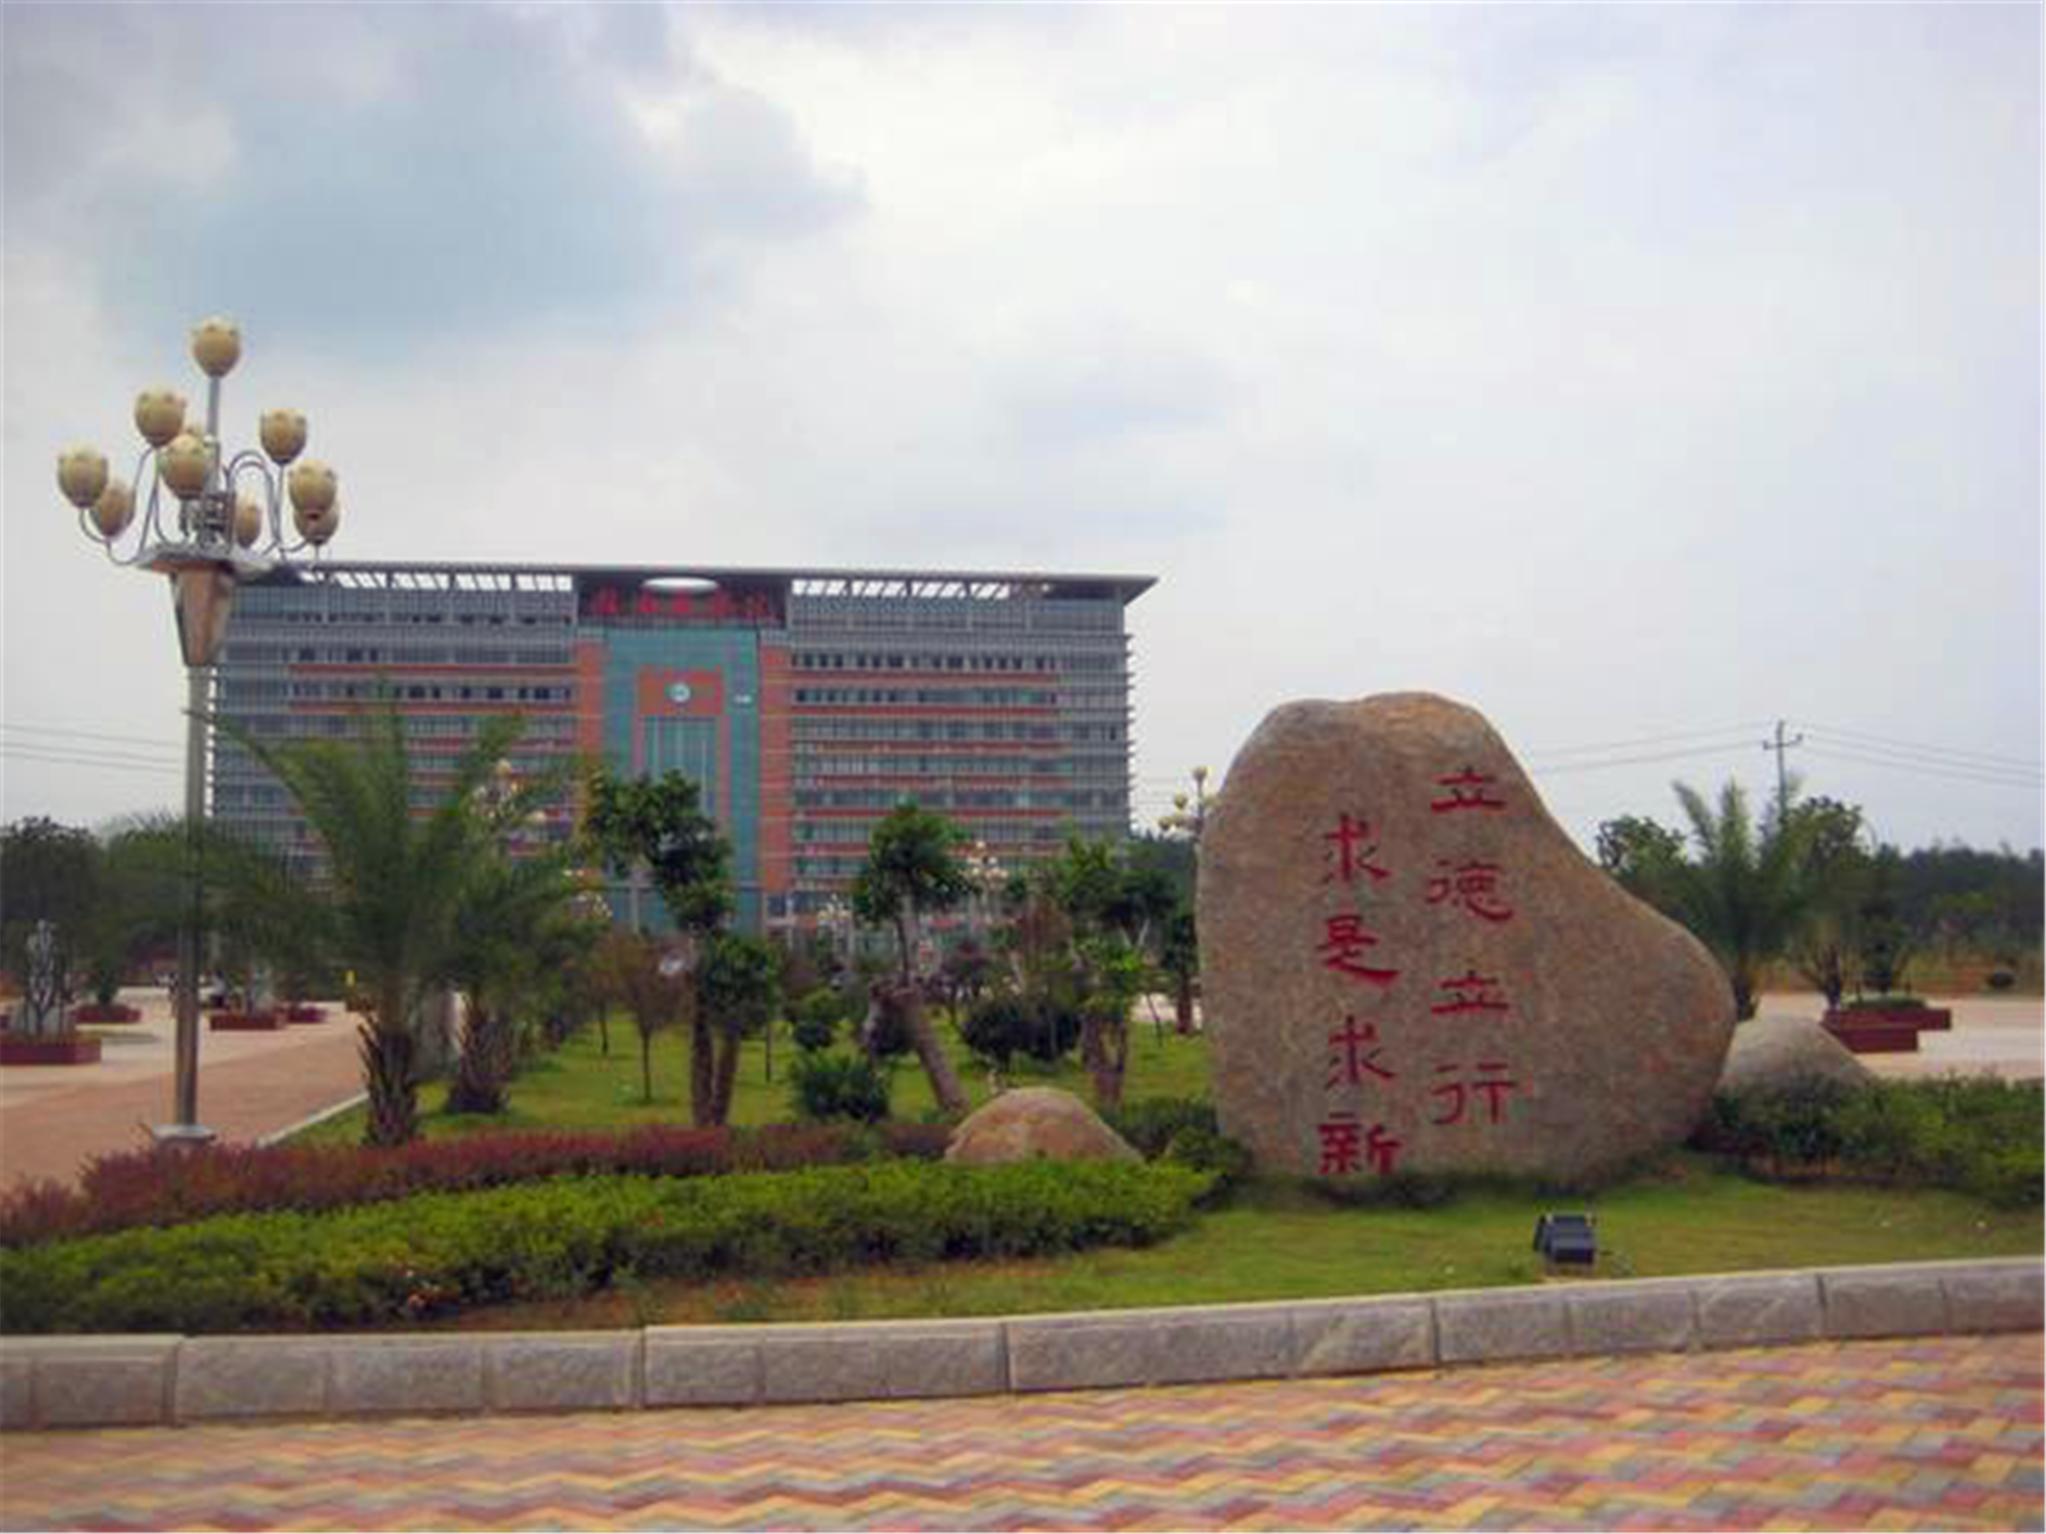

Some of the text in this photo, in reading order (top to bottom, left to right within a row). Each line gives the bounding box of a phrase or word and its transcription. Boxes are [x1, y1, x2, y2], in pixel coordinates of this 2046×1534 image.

[1315, 813, 1401, 1176] 求是求新
[1427, 767, 1517, 1125] 立德立行
